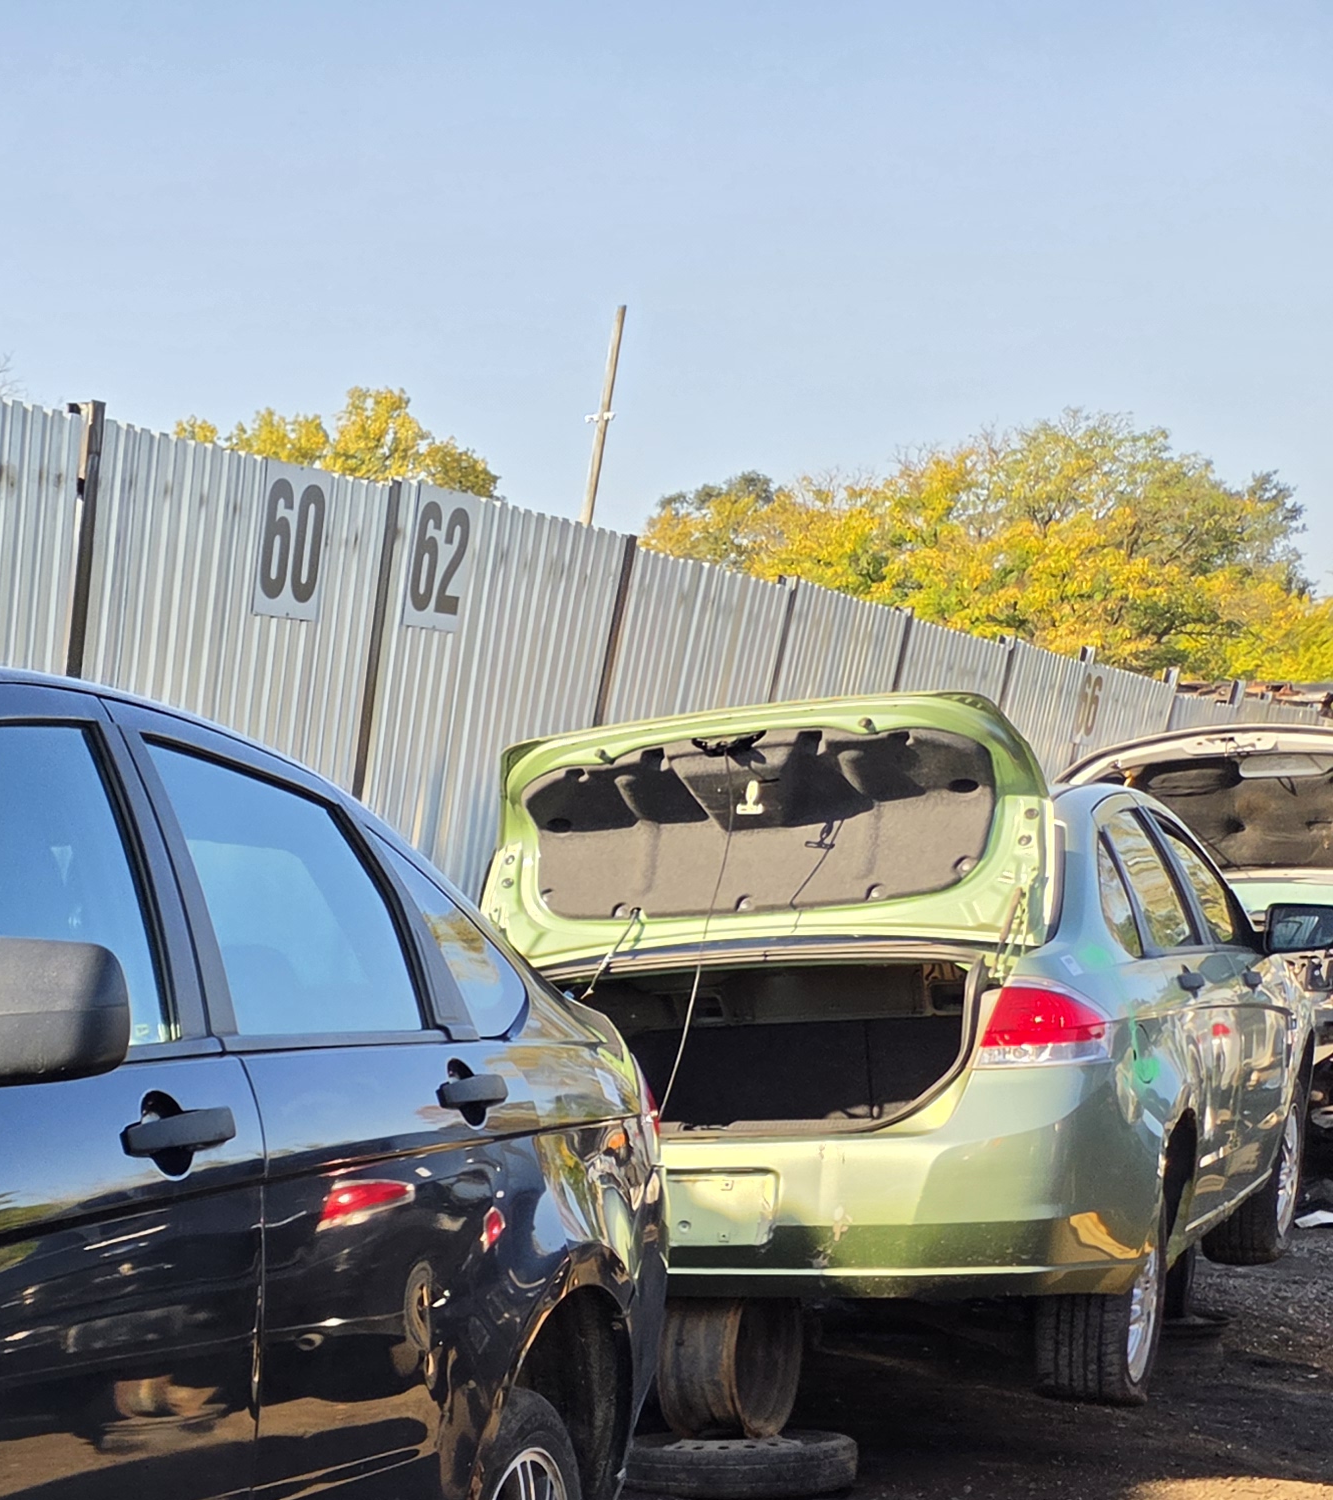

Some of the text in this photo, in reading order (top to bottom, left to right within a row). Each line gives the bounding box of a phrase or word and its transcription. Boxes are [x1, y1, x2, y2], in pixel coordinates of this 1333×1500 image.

[259, 478, 326, 603] 60
[409, 501, 470, 616] 62
[1074, 672, 1103, 737] 66
